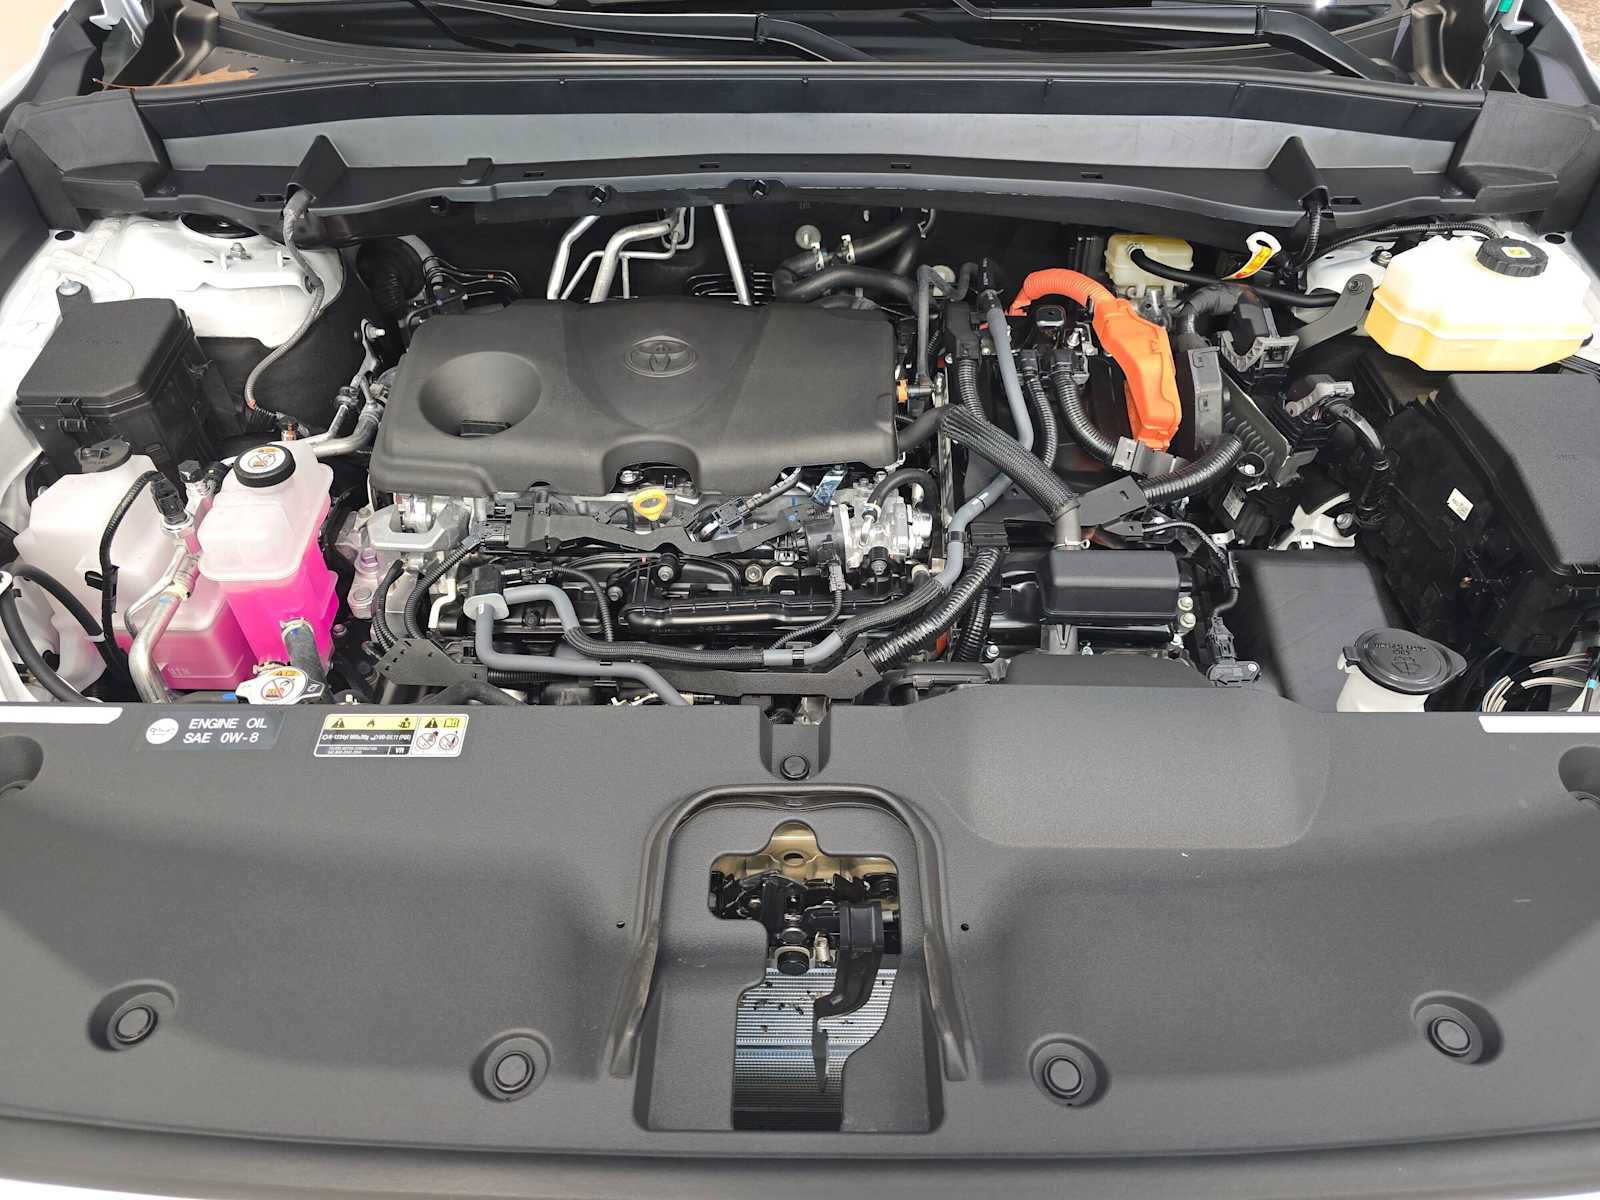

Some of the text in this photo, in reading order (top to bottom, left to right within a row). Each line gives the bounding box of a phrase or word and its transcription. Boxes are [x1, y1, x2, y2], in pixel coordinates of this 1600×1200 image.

[189, 718, 267, 729] ENGINE OIL
[183, 732, 259, 743] SAE 0W-8
